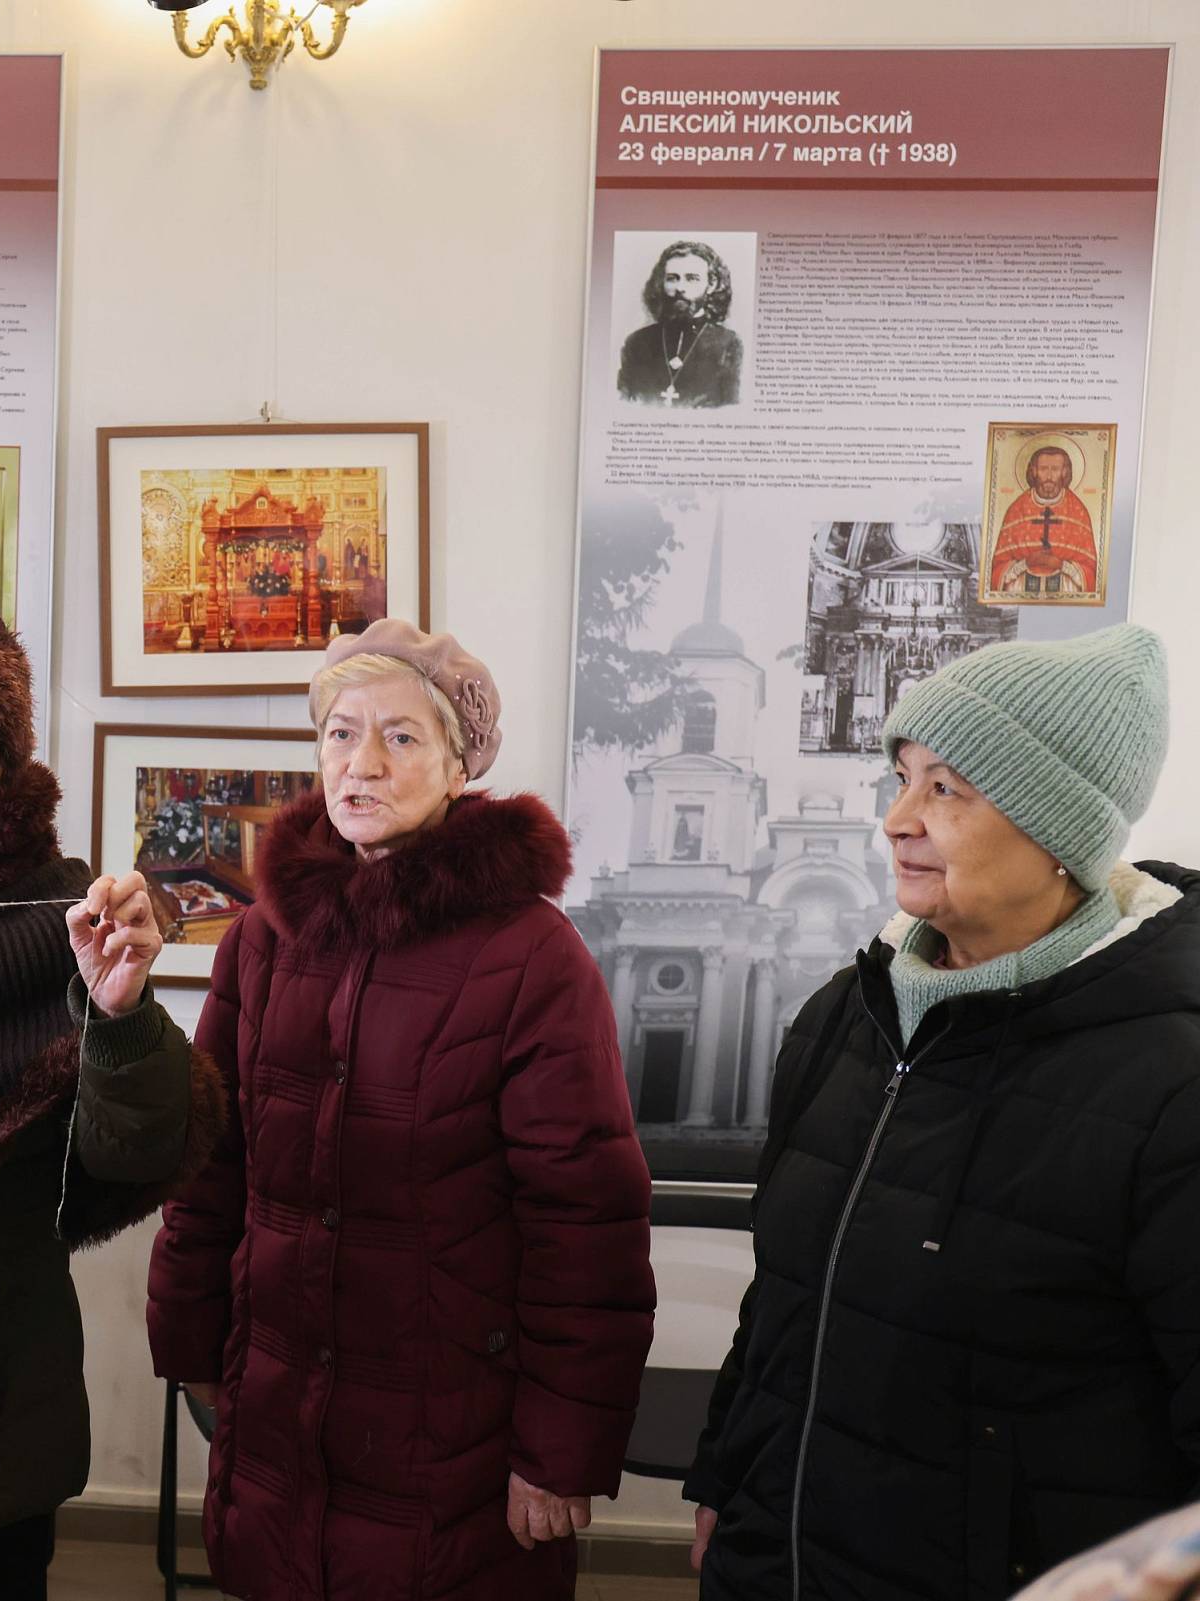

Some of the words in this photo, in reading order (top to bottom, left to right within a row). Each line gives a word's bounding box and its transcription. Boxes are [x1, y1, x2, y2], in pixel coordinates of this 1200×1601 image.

[620, 85, 841, 110] Священномученик
[618, 110, 737, 134] АЛЕКСИЙ
[742, 109, 913, 135] НИКОЛЬСКИЙ
[617, 141, 645, 161] 23
[650, 141, 754, 166] февраля
[758, 142, 770, 162] /
[773, 142, 788, 162] 7
[792, 146, 863, 167] марта
[897, 142, 958, 167] 1938)
